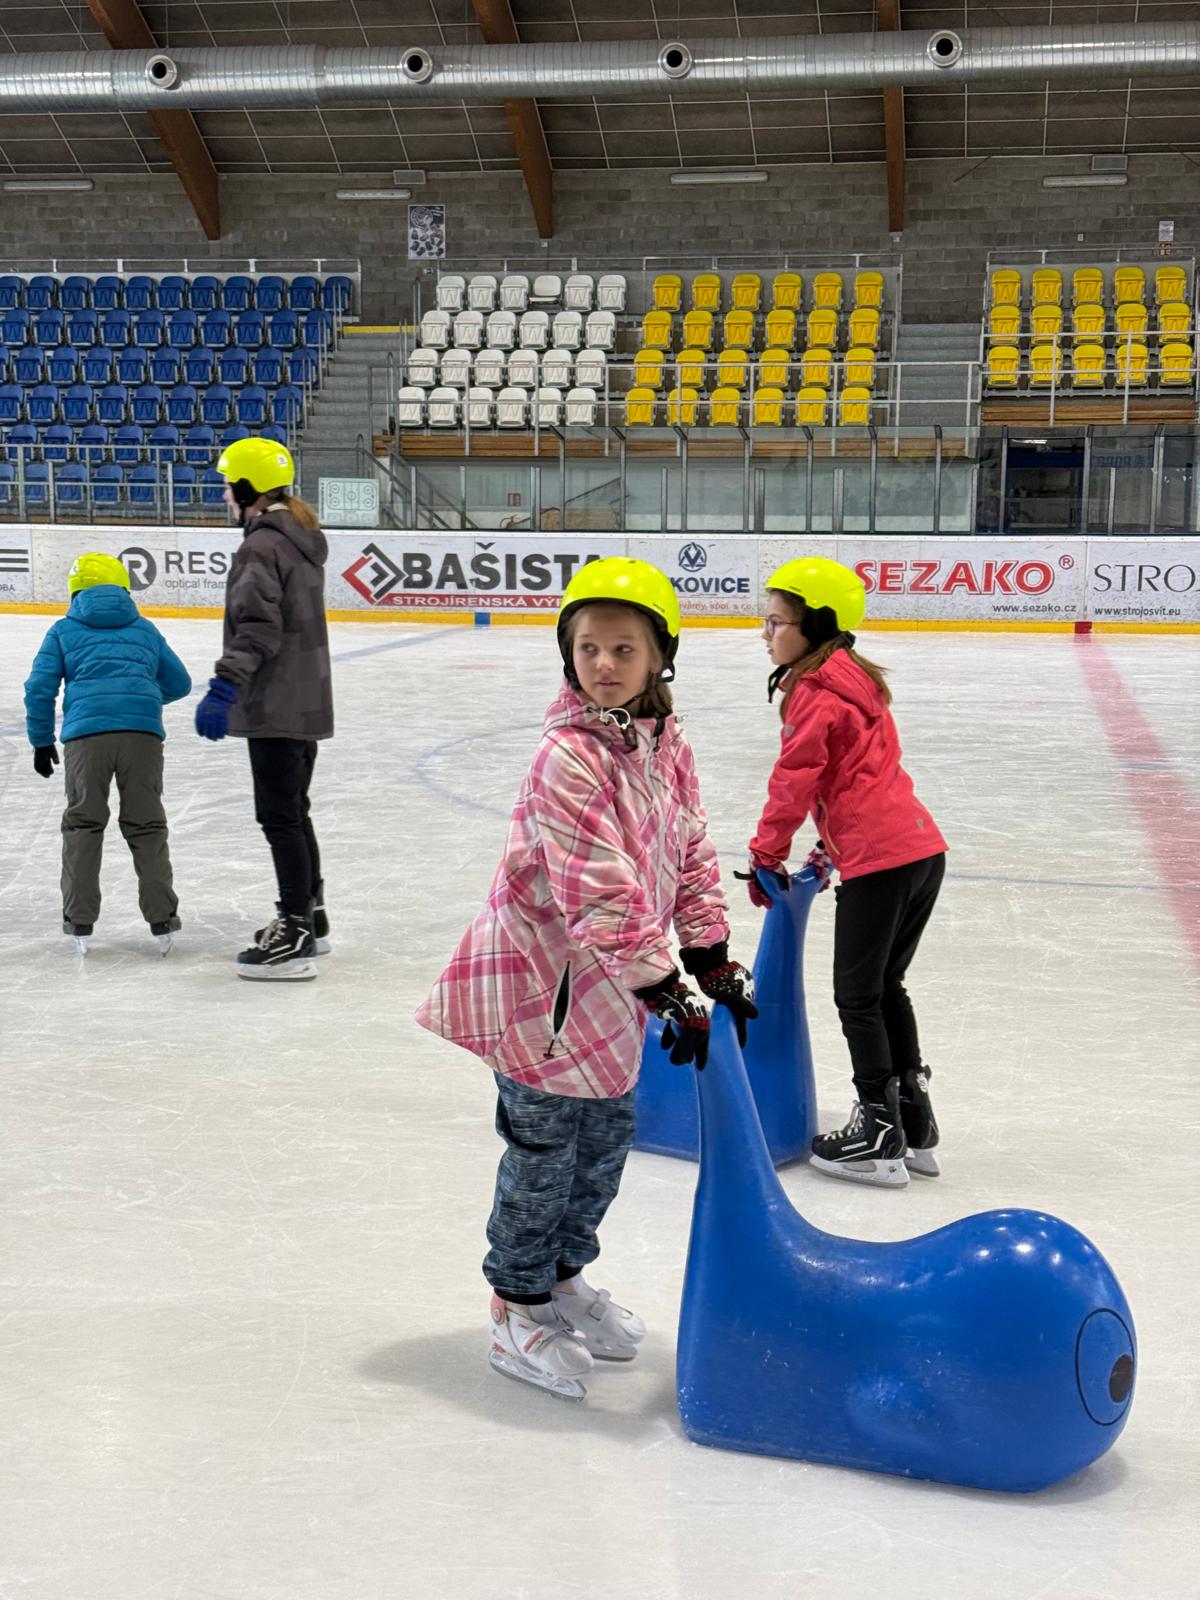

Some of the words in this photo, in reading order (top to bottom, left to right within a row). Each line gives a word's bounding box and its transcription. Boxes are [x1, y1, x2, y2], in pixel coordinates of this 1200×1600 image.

[164, 550, 238, 575] RES
[403, 542, 601, 591] BAŠIST
[164, 578, 200, 590] optical
[203, 578, 227, 589] fram
[668, 577, 750, 593] KOVICE
[854, 560, 1055, 596] SEZAKO
[1093, 563, 1200, 592] STRO
[393, 595, 528, 607] STROJÍRENSKÁ
[993, 603, 1077, 613] www.sezako.cz
[1094, 606, 1181, 617] www.strojosvit.eu
